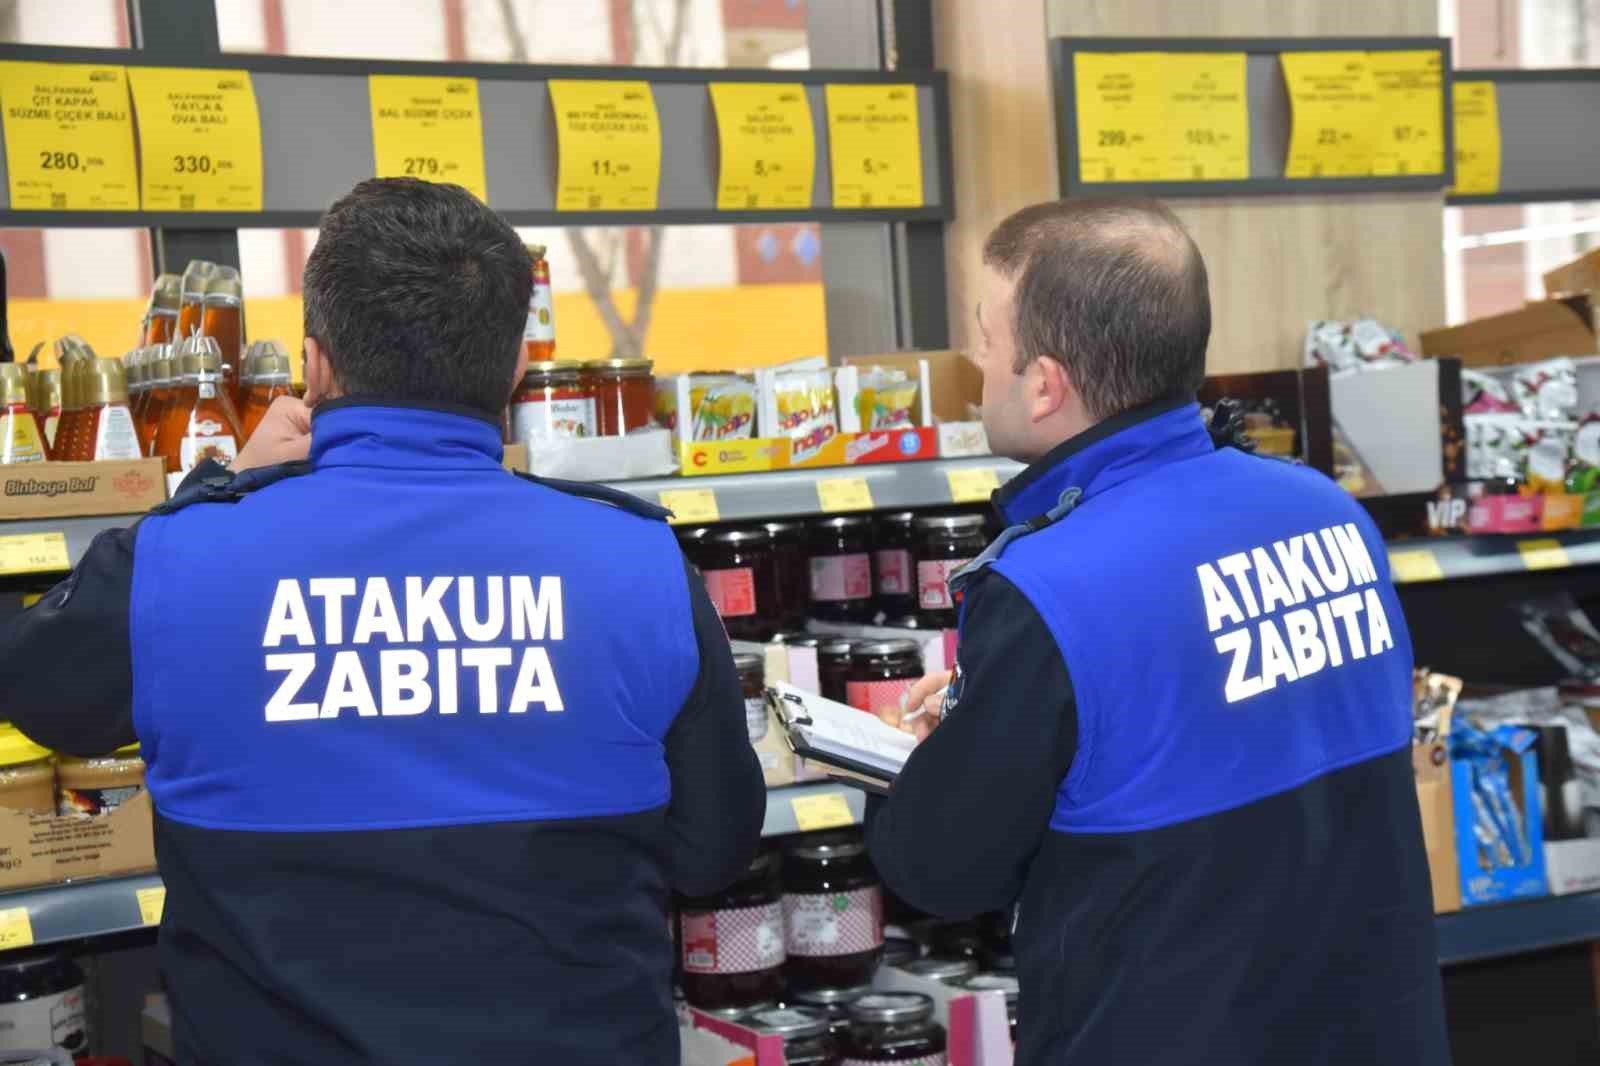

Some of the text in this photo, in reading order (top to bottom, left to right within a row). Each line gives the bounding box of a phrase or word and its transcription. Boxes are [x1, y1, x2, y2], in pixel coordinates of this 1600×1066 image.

[1426, 498, 1467, 529] VIP
[262, 575, 564, 647] ATAKUM
[1196, 522, 1378, 632] ATAKUM
[264, 646, 565, 721] ZABITA
[1214, 588, 1394, 704] ZABITA
